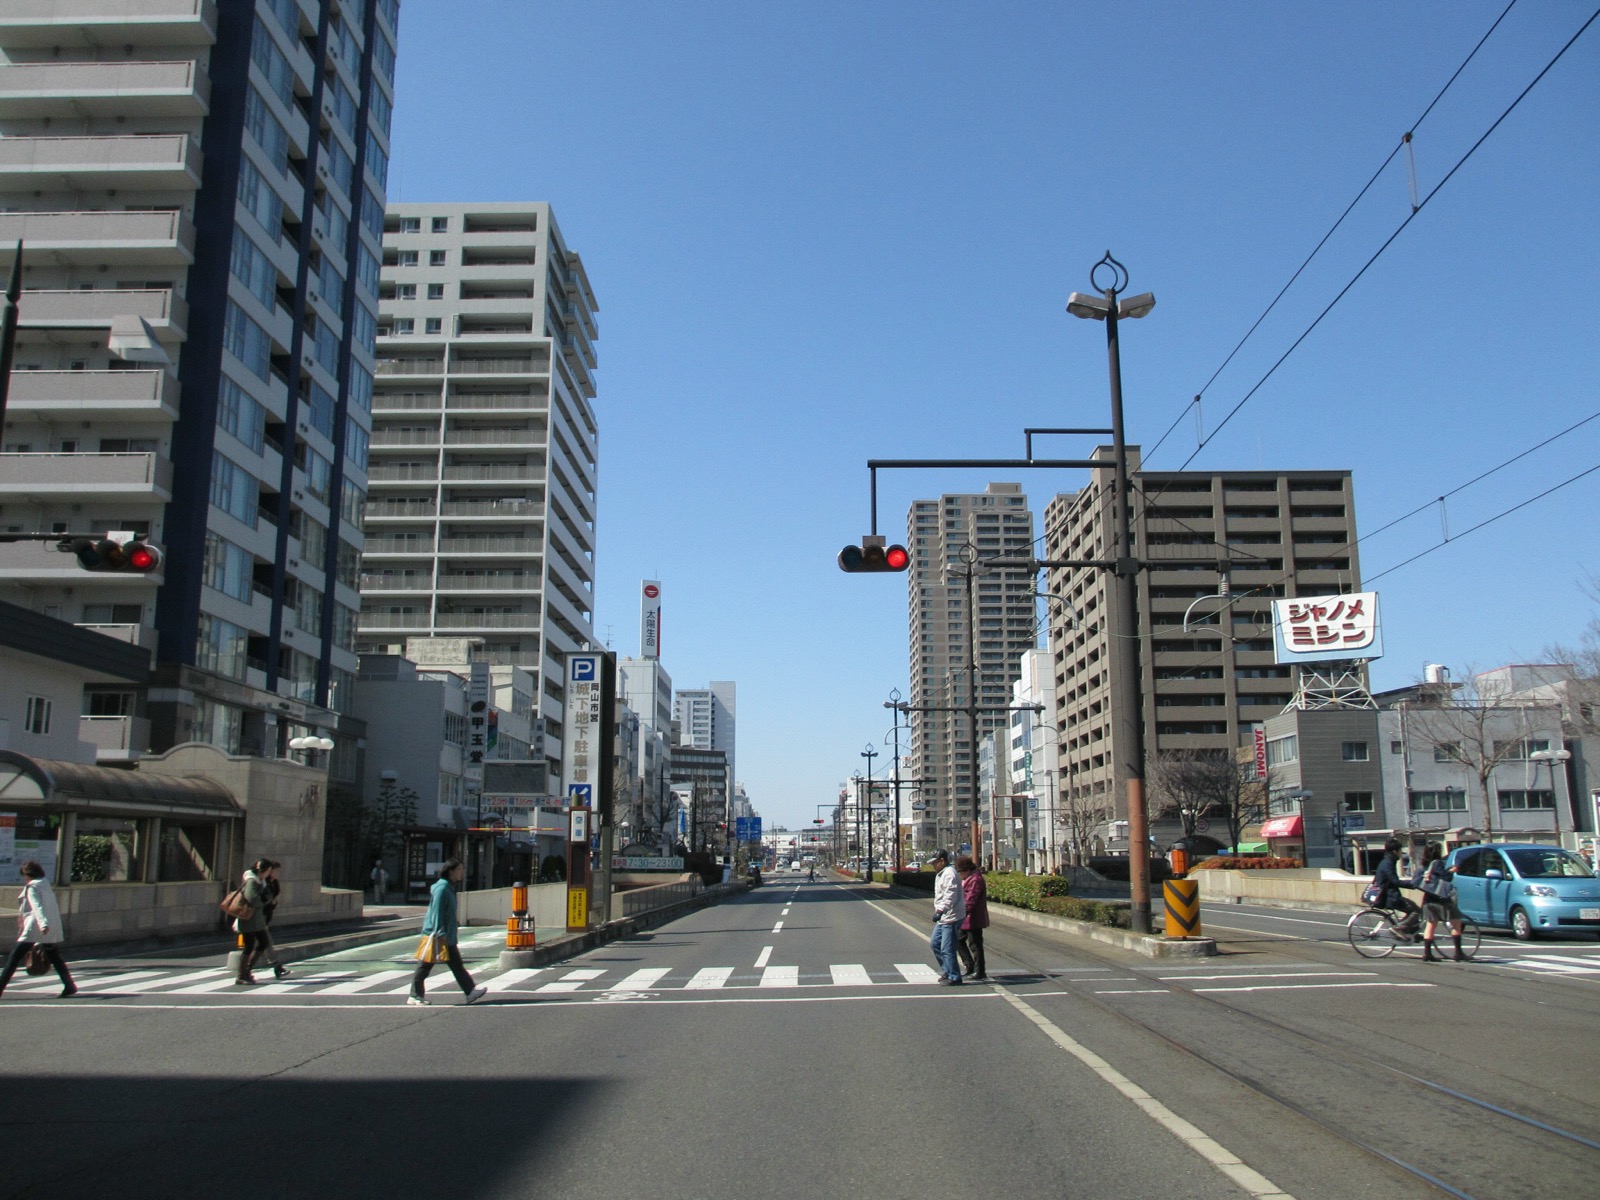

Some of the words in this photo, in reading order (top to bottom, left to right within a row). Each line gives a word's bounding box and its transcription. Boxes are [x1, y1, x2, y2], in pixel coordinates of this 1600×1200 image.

[646, 610, 656, 647] 太陽生命
[1289, 599, 1364, 624] ジャノメ
[1292, 622, 1366, 645] ミシン
[574, 660, 593, 679] P
[590, 682, 599, 723] 岡山市営
[574, 682, 590, 783] 城下地下駐車場
[1254, 728, 1266, 779] JANOME
